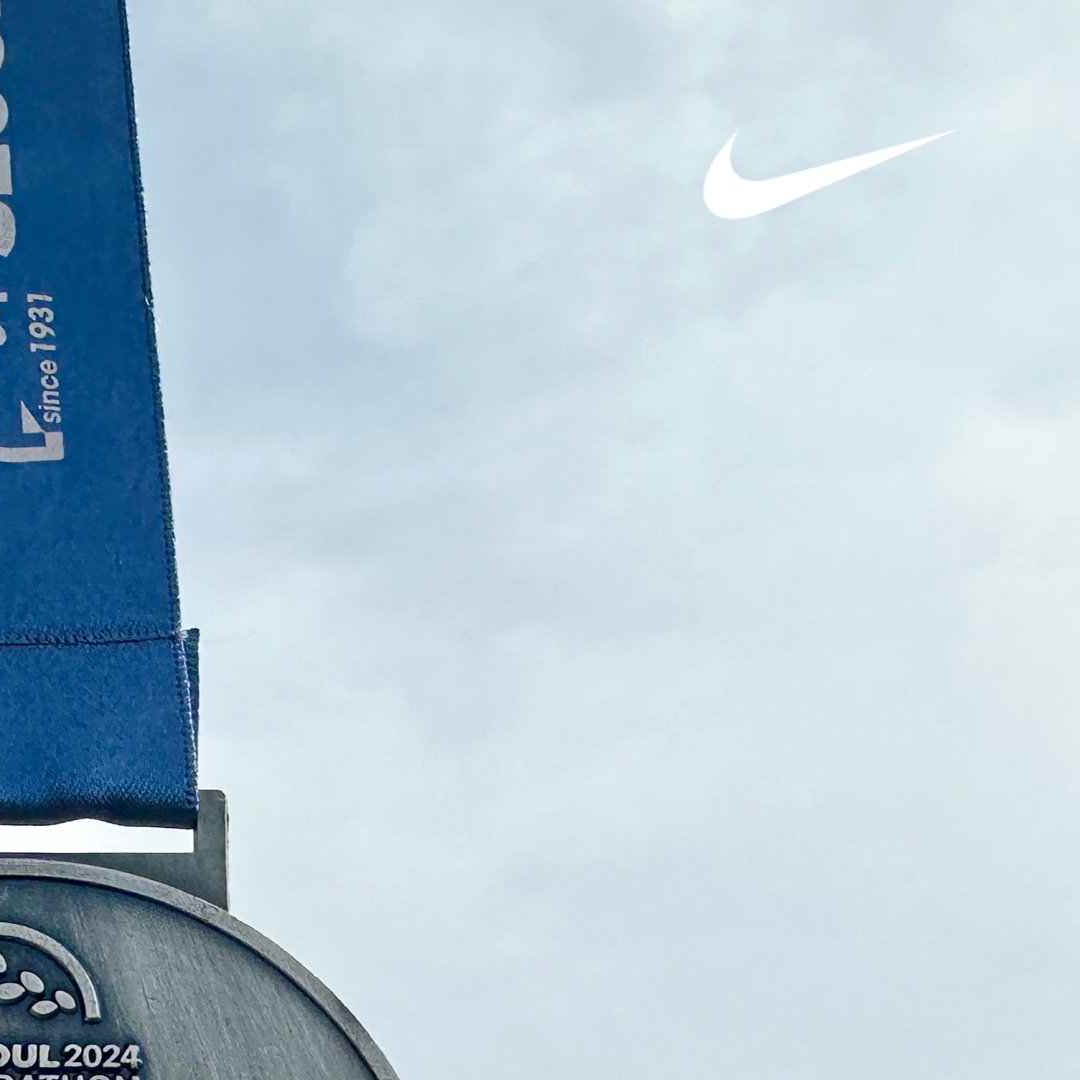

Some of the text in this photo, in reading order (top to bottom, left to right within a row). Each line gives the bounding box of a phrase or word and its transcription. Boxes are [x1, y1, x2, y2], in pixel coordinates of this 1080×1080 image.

[27, 293, 61, 423] since 1931
[63, 1043, 143, 1069] 2024
